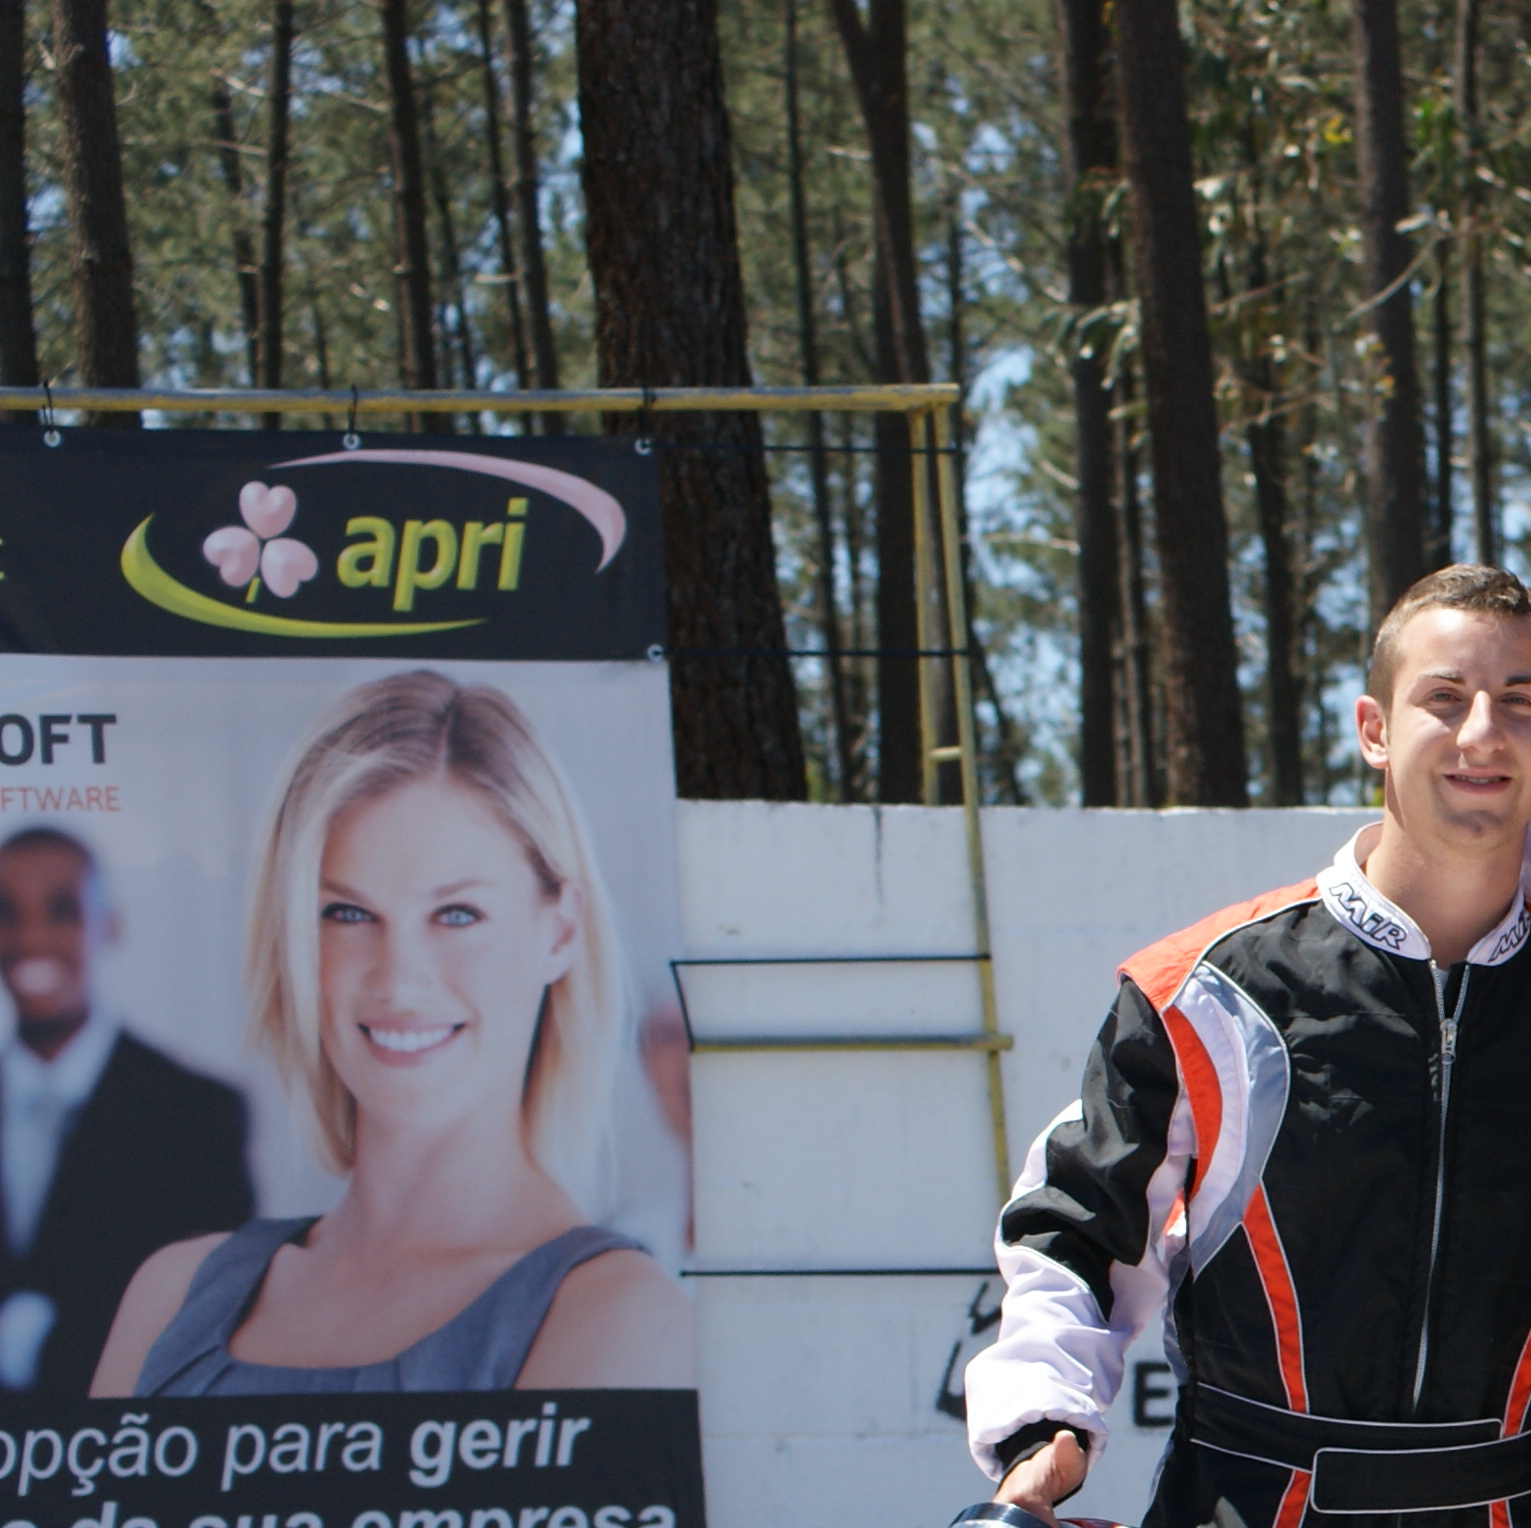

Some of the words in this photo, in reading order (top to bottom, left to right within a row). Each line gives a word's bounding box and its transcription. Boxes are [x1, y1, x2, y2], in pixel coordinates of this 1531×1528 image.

[336, 497, 528, 612] apri
[220, 1418, 384, 1493] para
[408, 1403, 591, 1489] gerir
